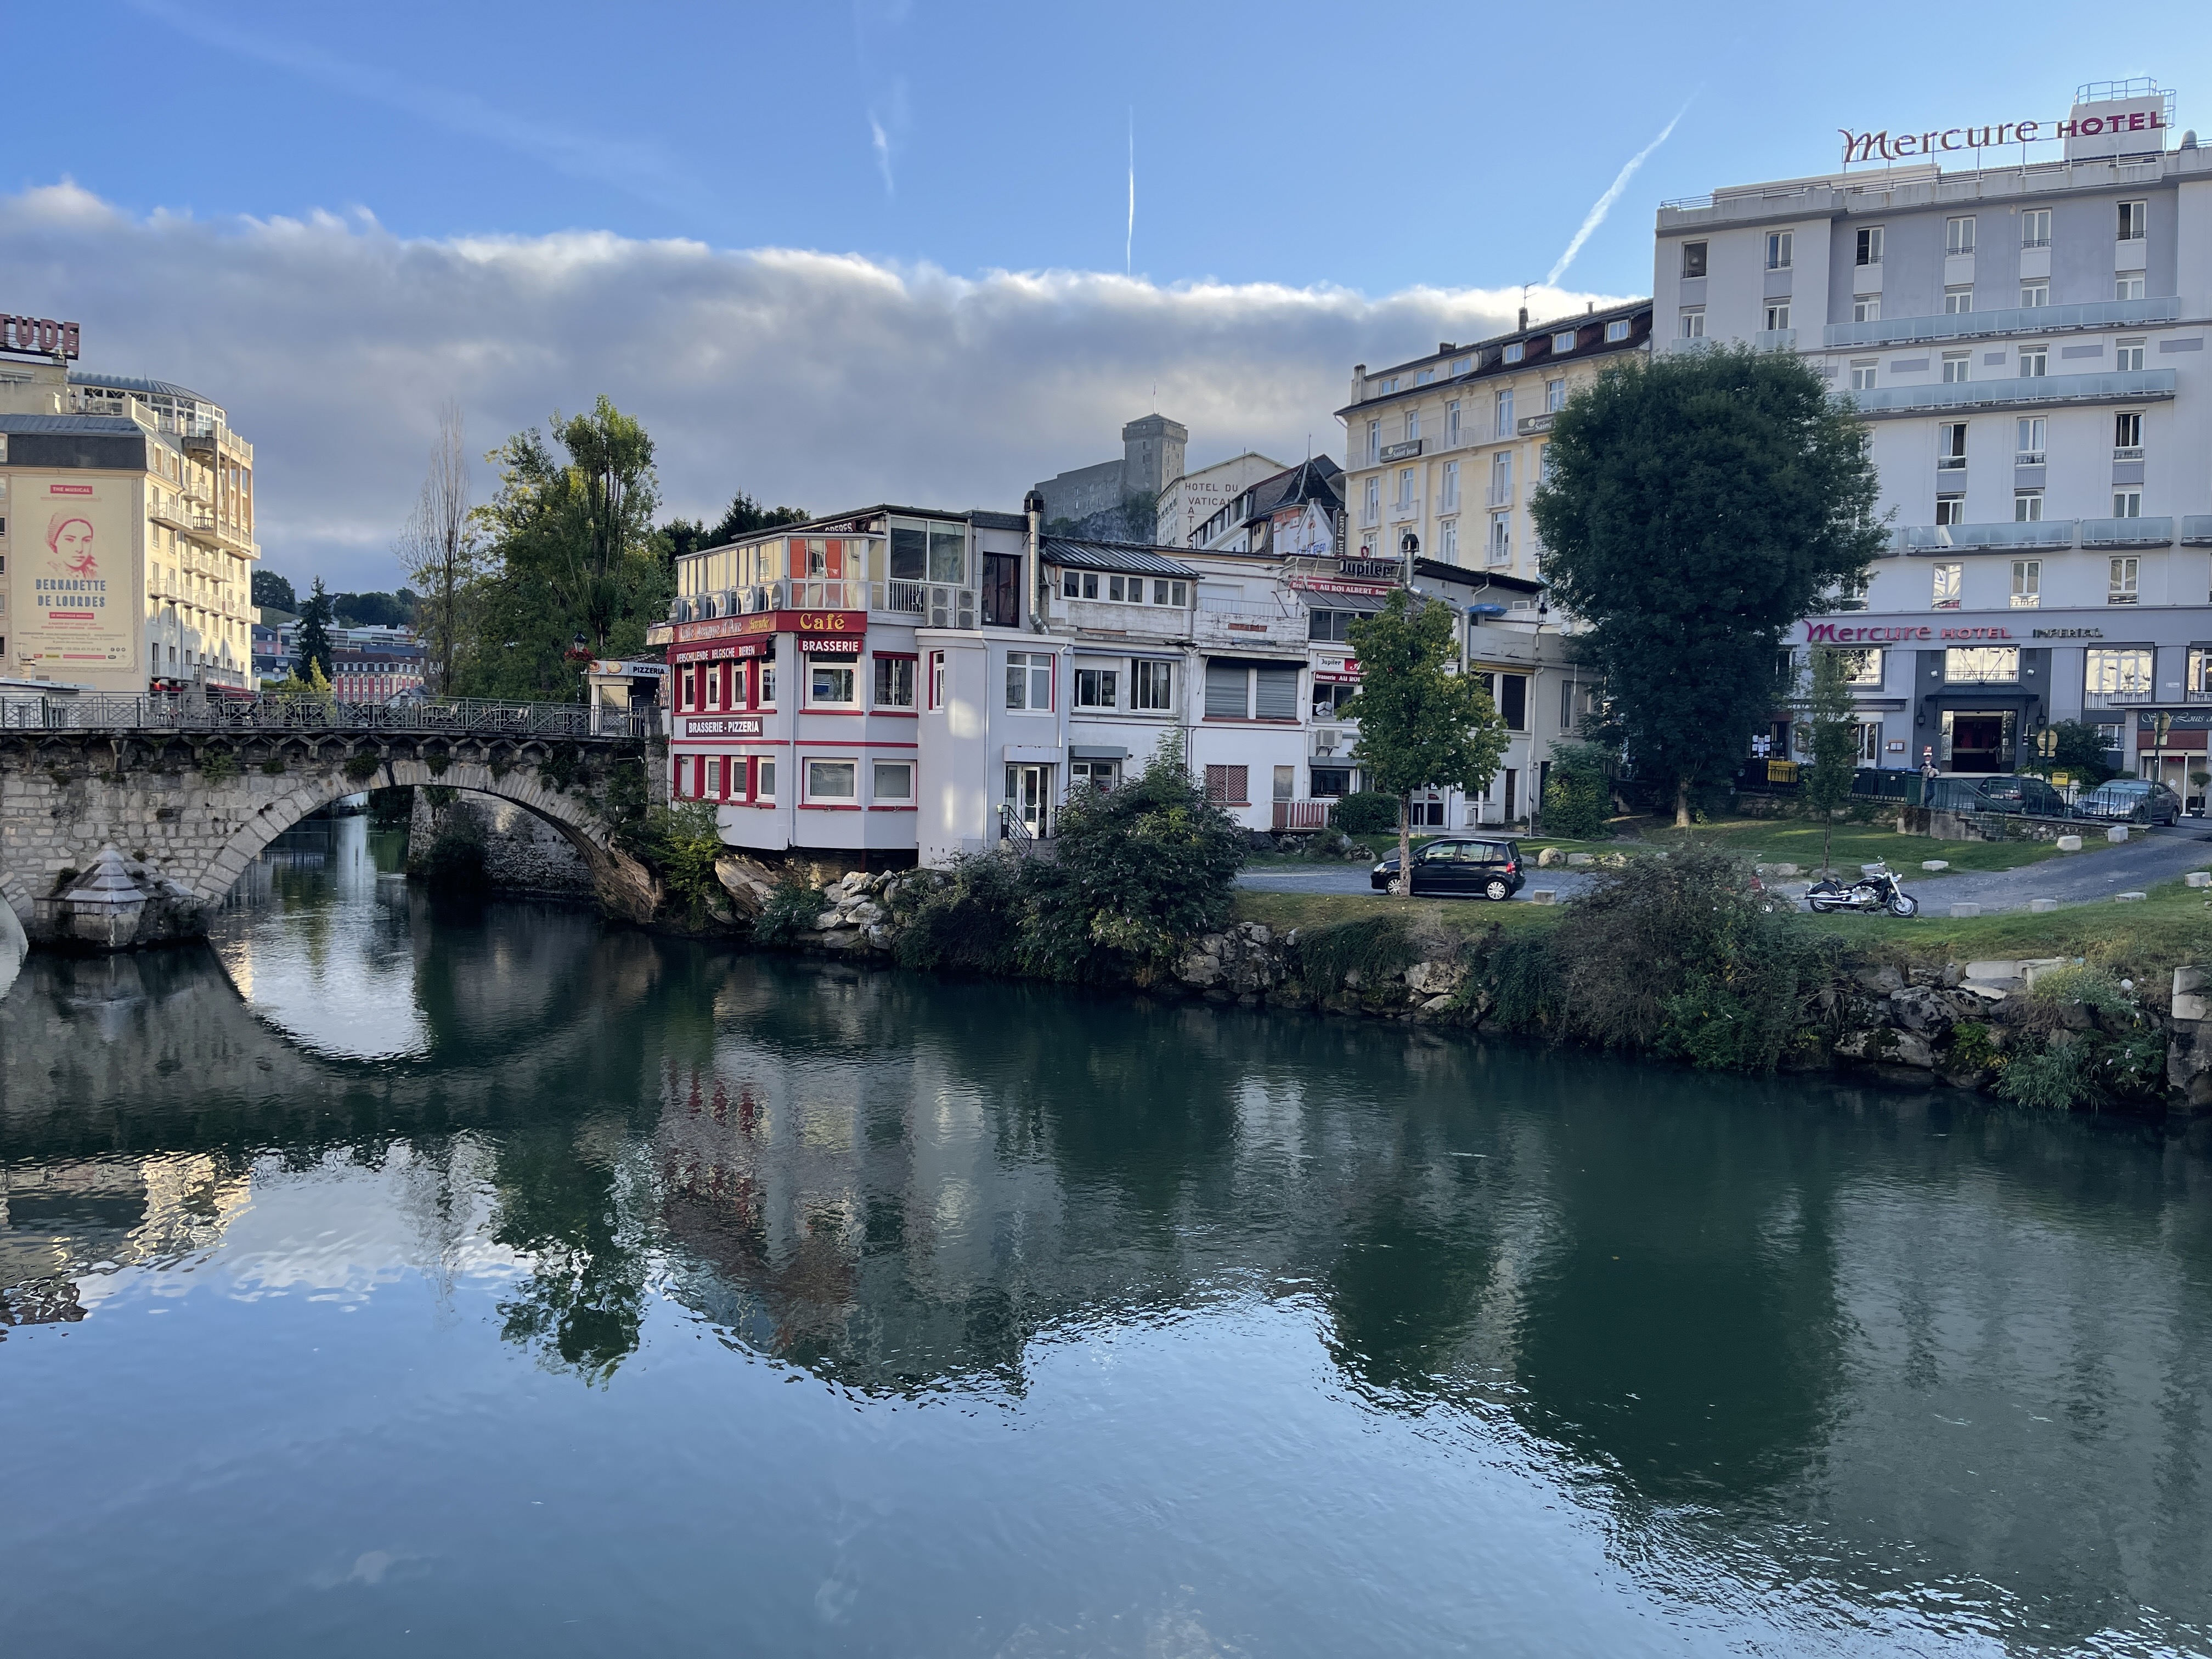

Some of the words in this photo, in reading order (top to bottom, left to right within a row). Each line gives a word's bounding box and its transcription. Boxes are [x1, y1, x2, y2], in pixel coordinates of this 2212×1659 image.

[1837, 120, 2039, 162] Mercure
[2057, 111, 2166, 138] HOTEL
[1534, 421, 1552, 431] Saint
[1392, 449, 1406, 458] Saint
[1406, 447, 1418, 456] Jean
[1184, 482, 1218, 492] HOTEL
[1225, 484, 1238, 492] DU
[1339, 559, 1392, 578] Jupiler
[36, 579, 106, 591] BERNADETTE
[1345, 586, 1372, 595] ALBERT
[38, 595, 51, 606] DE
[56, 595, 105, 607] LOURDES
[799, 613, 845, 630] Café
[1802, 619, 1932, 643] Mercure
[1940, 627, 2012, 640] HOTEL
[2033, 628, 2103, 639] IMPERIAL
[802, 640, 859, 652] BRASSERIE
[676, 650, 708, 663] VERSCHILLENDE
[712, 647, 735, 659] BELGISCHE
[738, 645, 755, 657] BIEREN
[633, 666, 665, 674] PIZZERIA
[689, 721, 723, 733] BRASSERIE
[727, 721, 760, 732] PIZZERIA
